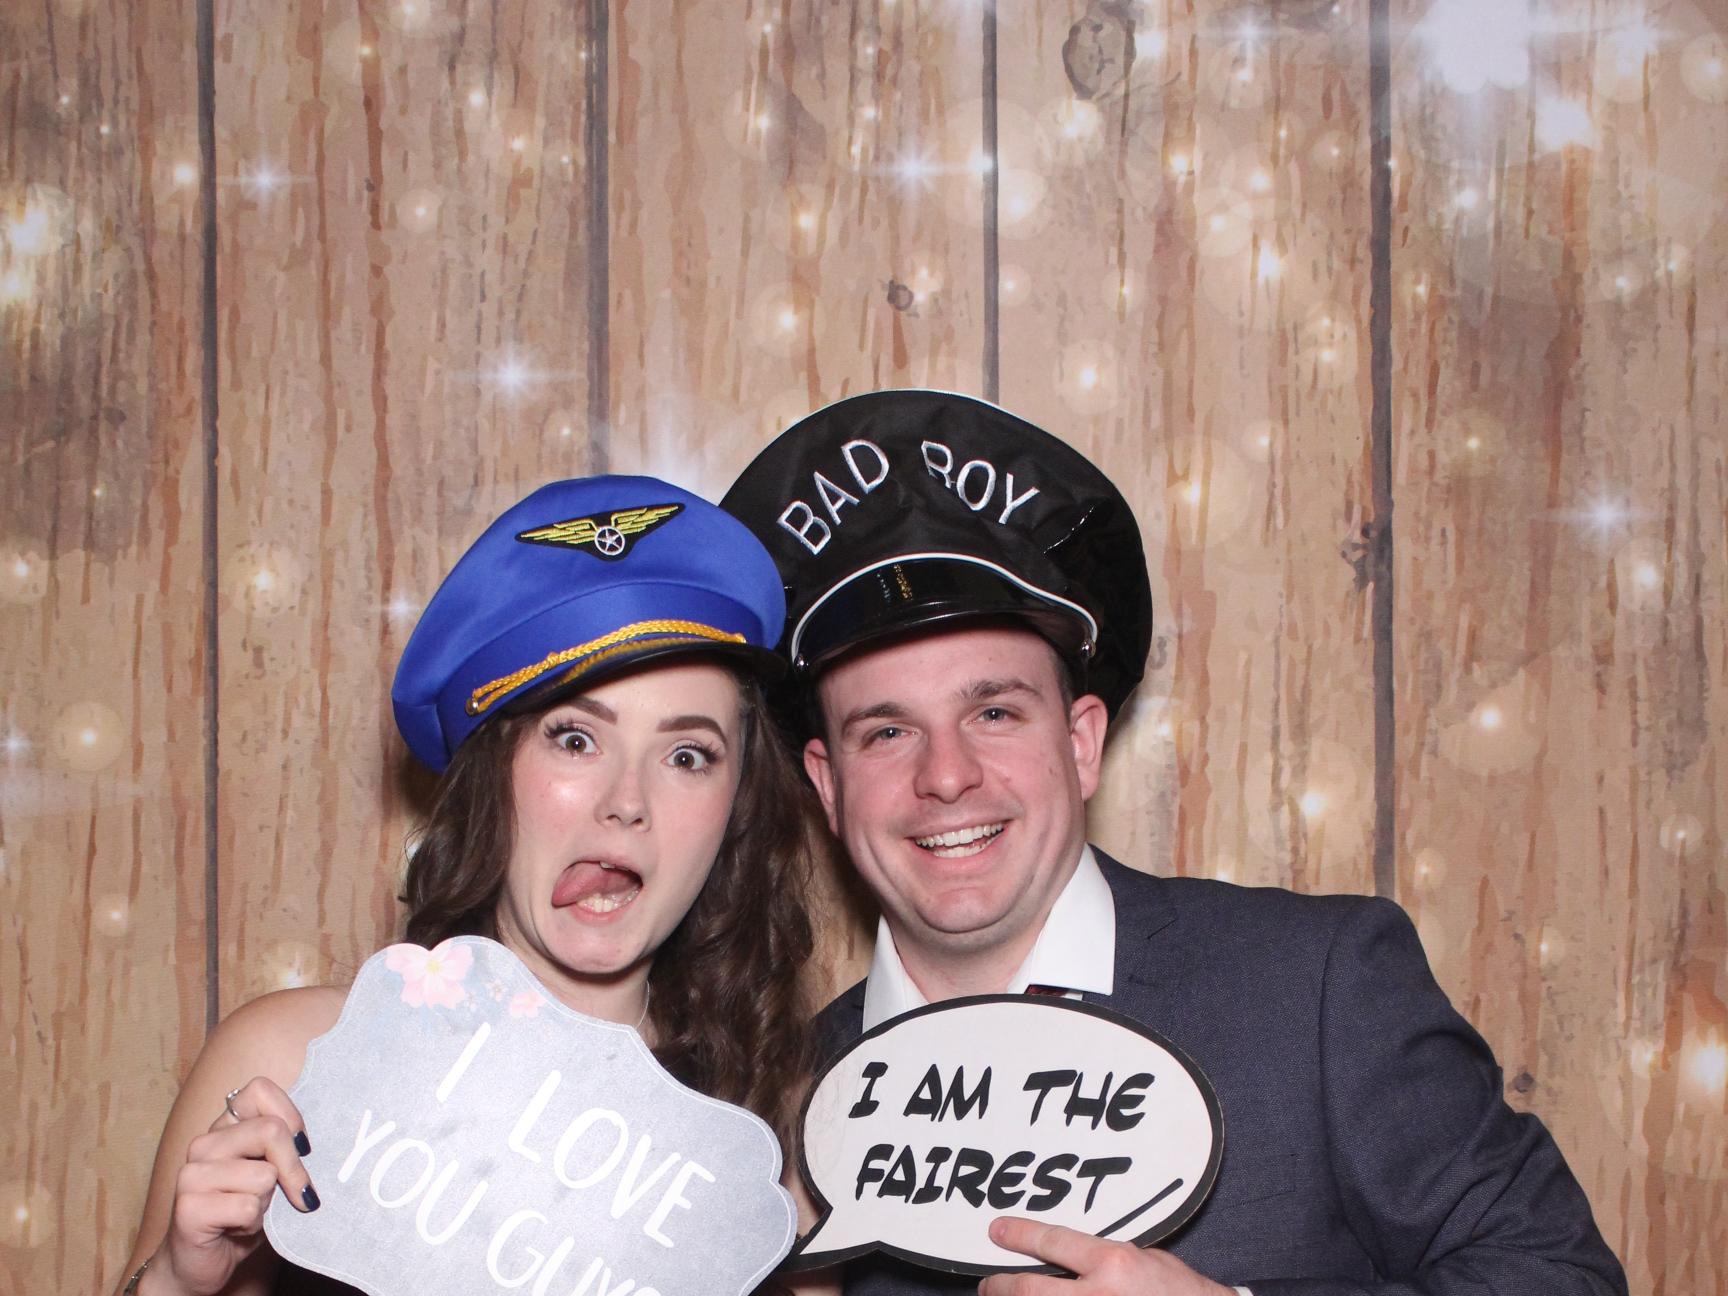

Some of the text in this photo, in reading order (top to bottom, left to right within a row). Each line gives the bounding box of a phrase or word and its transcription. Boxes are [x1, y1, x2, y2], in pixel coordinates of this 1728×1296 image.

[777, 439, 890, 556] BAD
[436, 1021, 716, 1249] I LOVE
[848, 1061, 1156, 1132] I AM THE
[337, 1109, 489, 1246] YOU
[854, 1143, 1133, 1214] FAIREST
